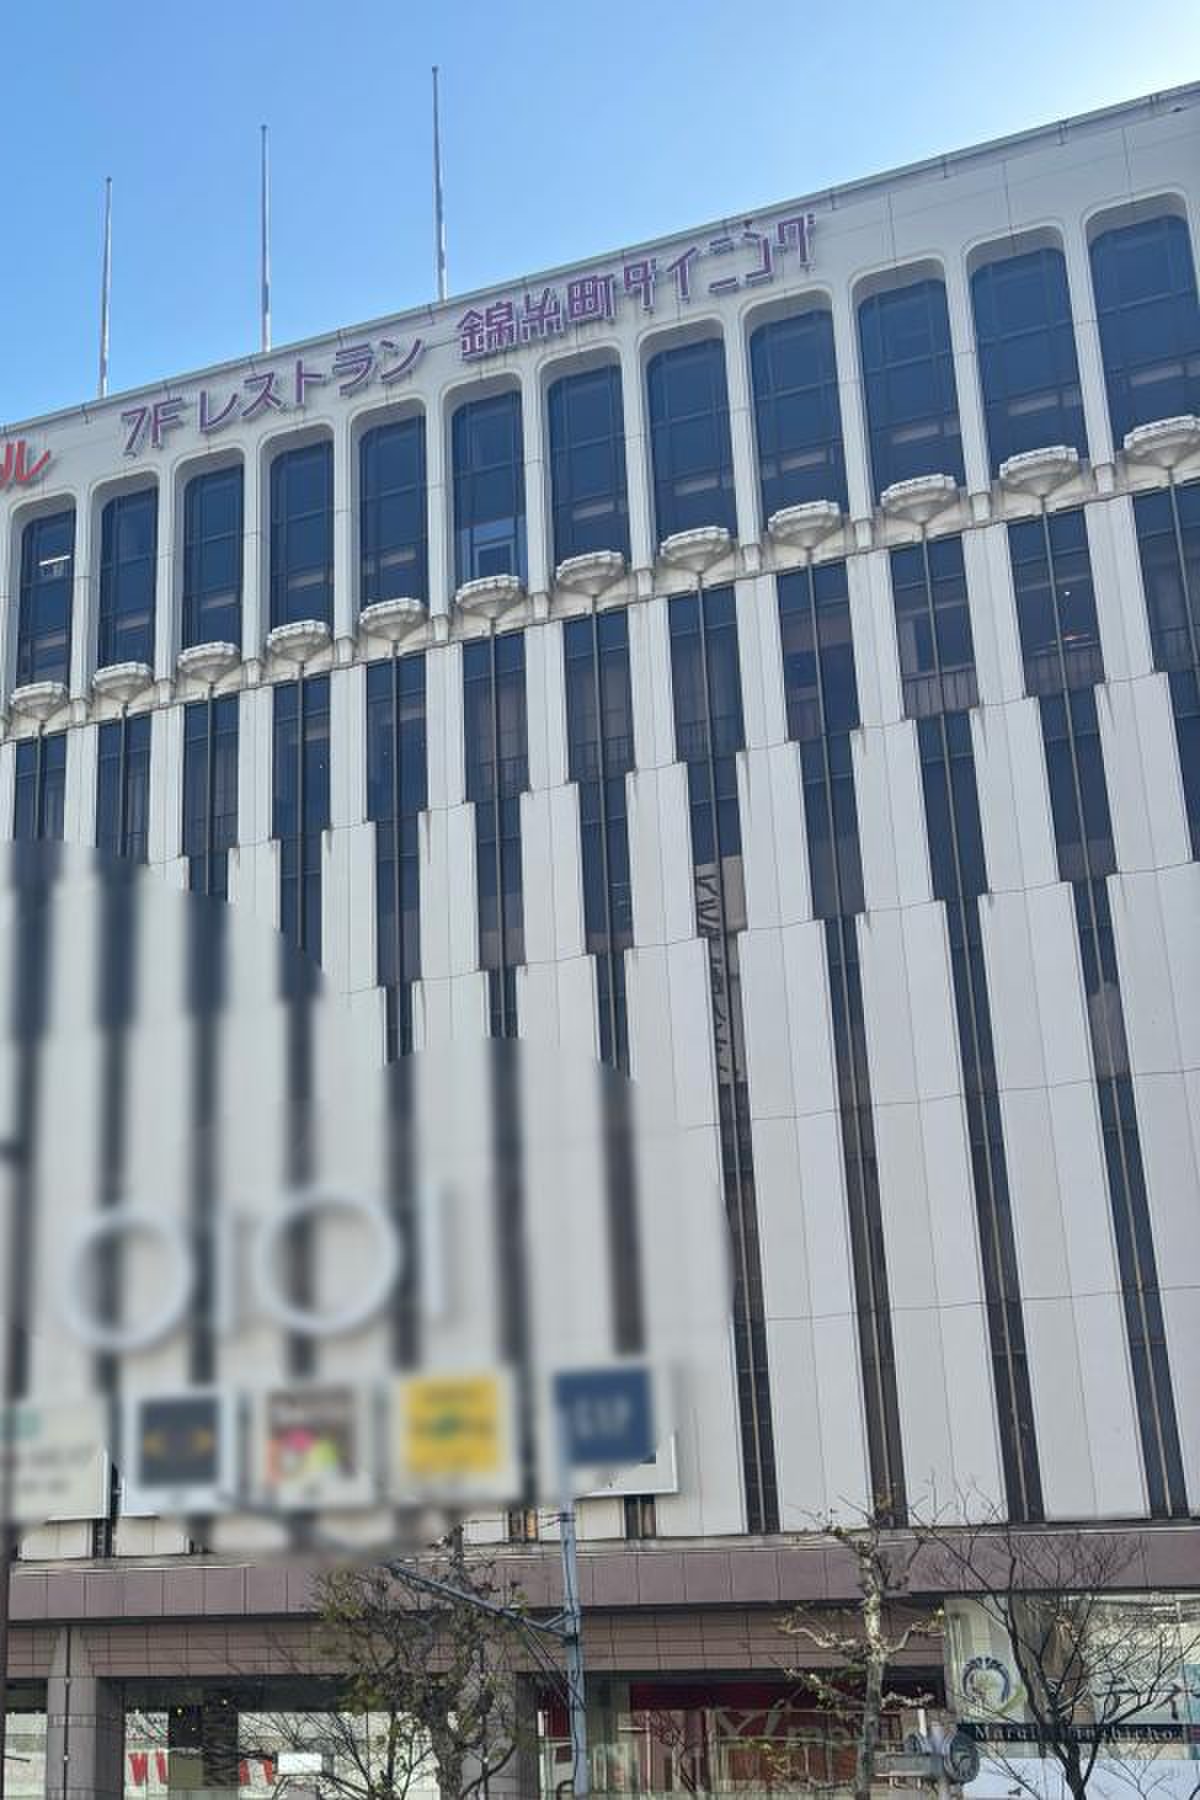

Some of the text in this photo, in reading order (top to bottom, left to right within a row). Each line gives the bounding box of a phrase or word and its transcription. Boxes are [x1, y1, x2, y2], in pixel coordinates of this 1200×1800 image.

[456, 211, 818, 362] 錦糸町ダイニング
